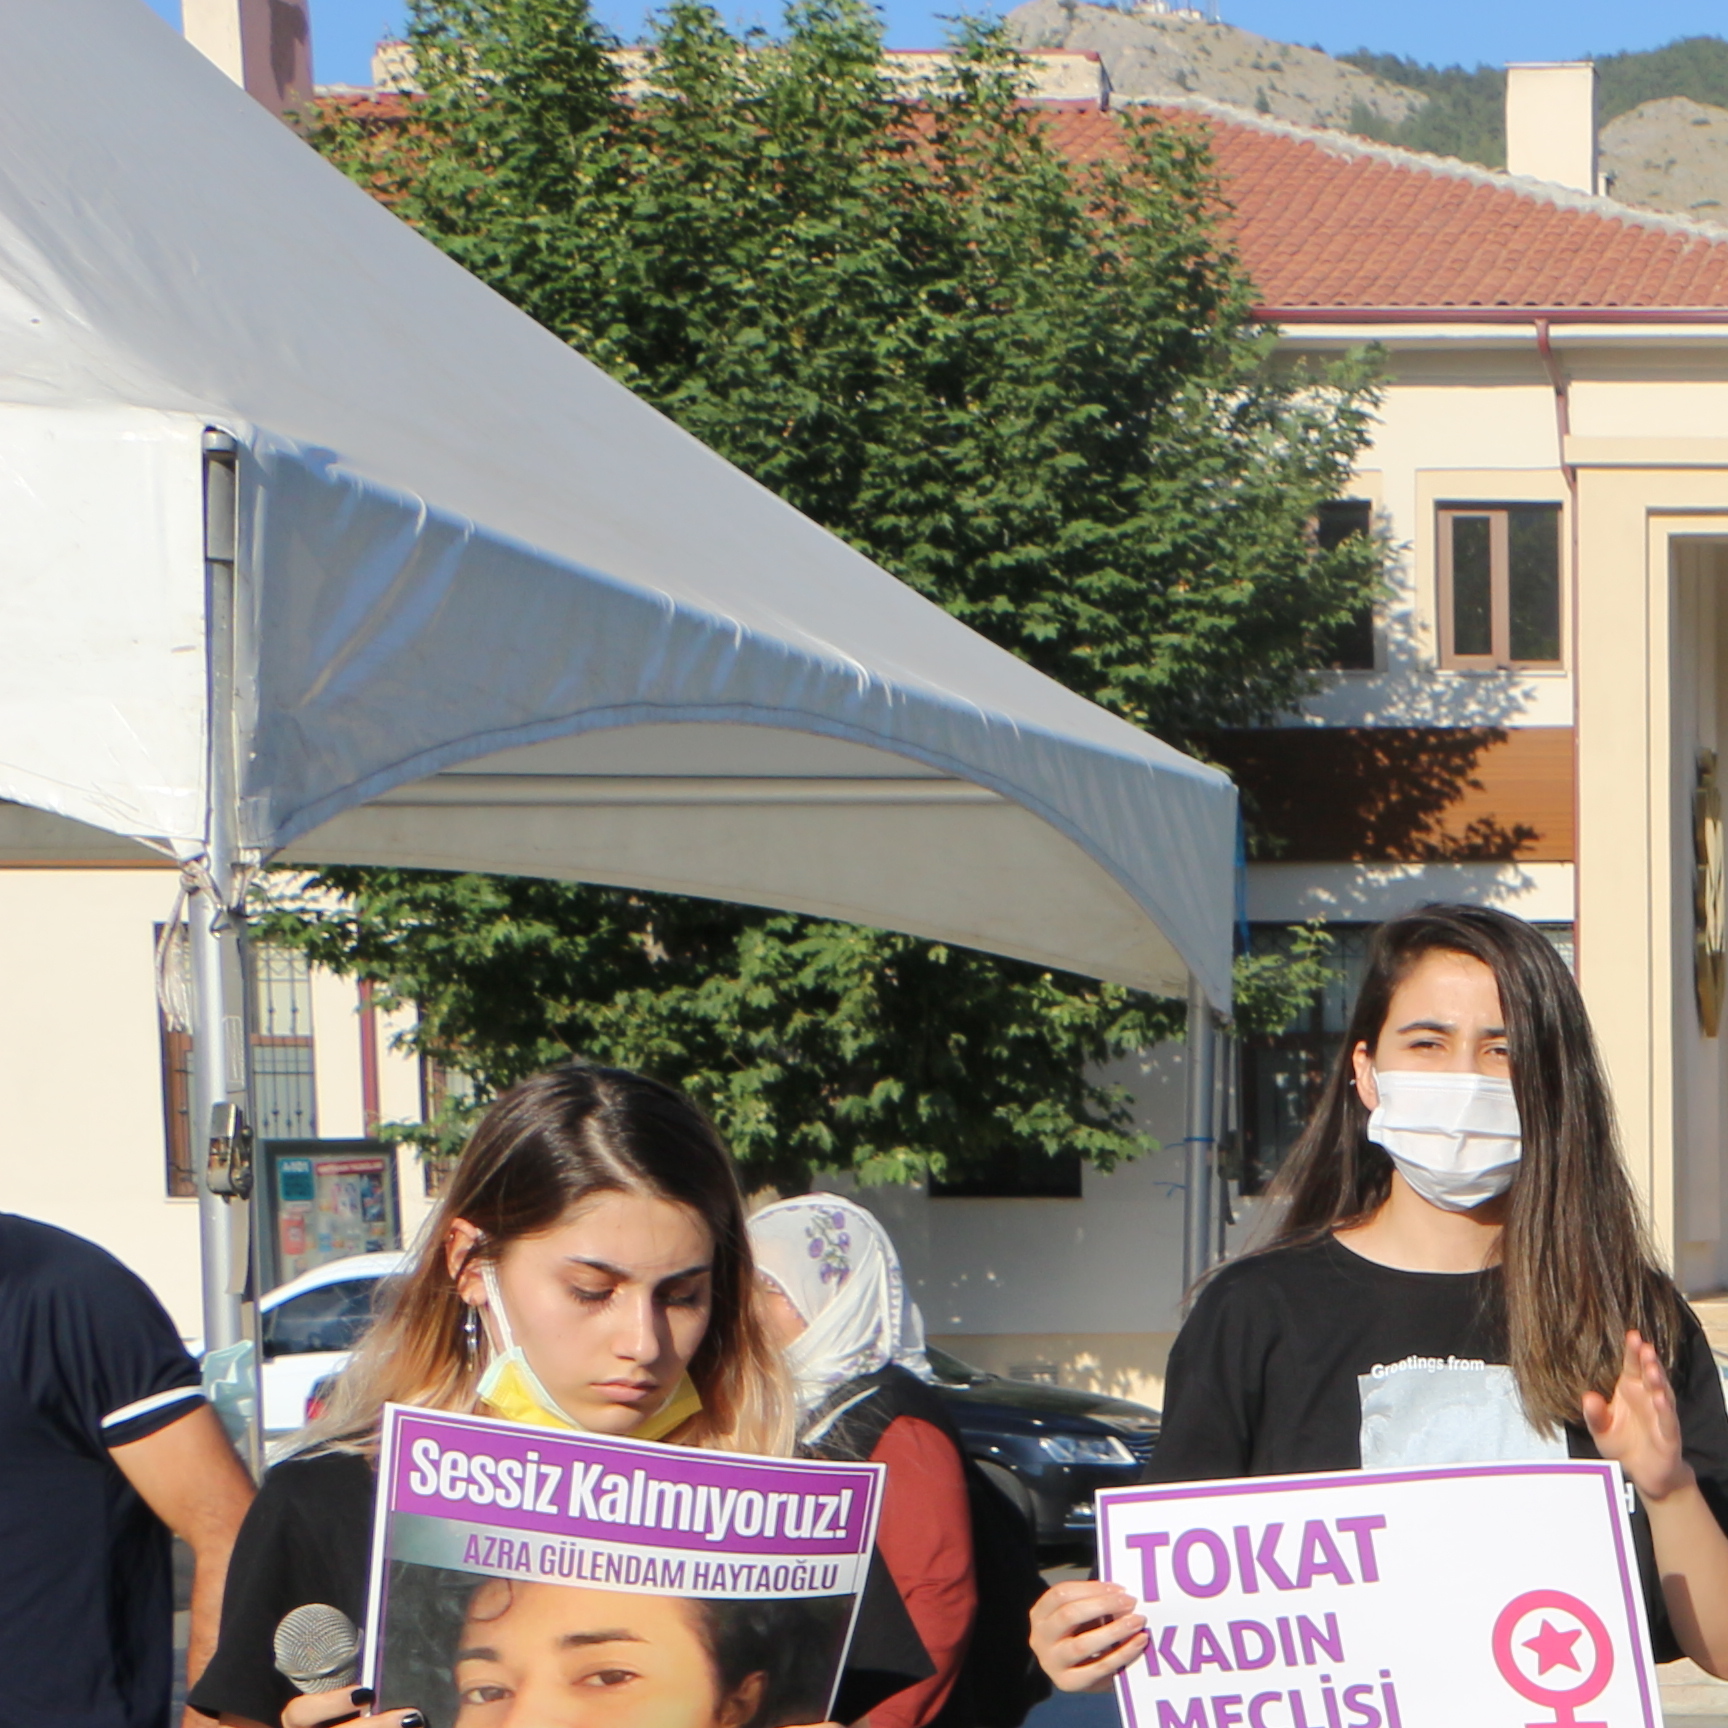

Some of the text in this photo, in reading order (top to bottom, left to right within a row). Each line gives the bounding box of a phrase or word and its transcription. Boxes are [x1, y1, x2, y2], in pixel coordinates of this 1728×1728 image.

[408, 1436, 856, 1543] Sessiz Kalmıyoruz!
[462, 1533, 840, 1594] AZRA GÜLENDAM HAYTAOĞLU
[1125, 1513, 1387, 1603] TOKAT
[1144, 1610, 1345, 1678] KADIN
